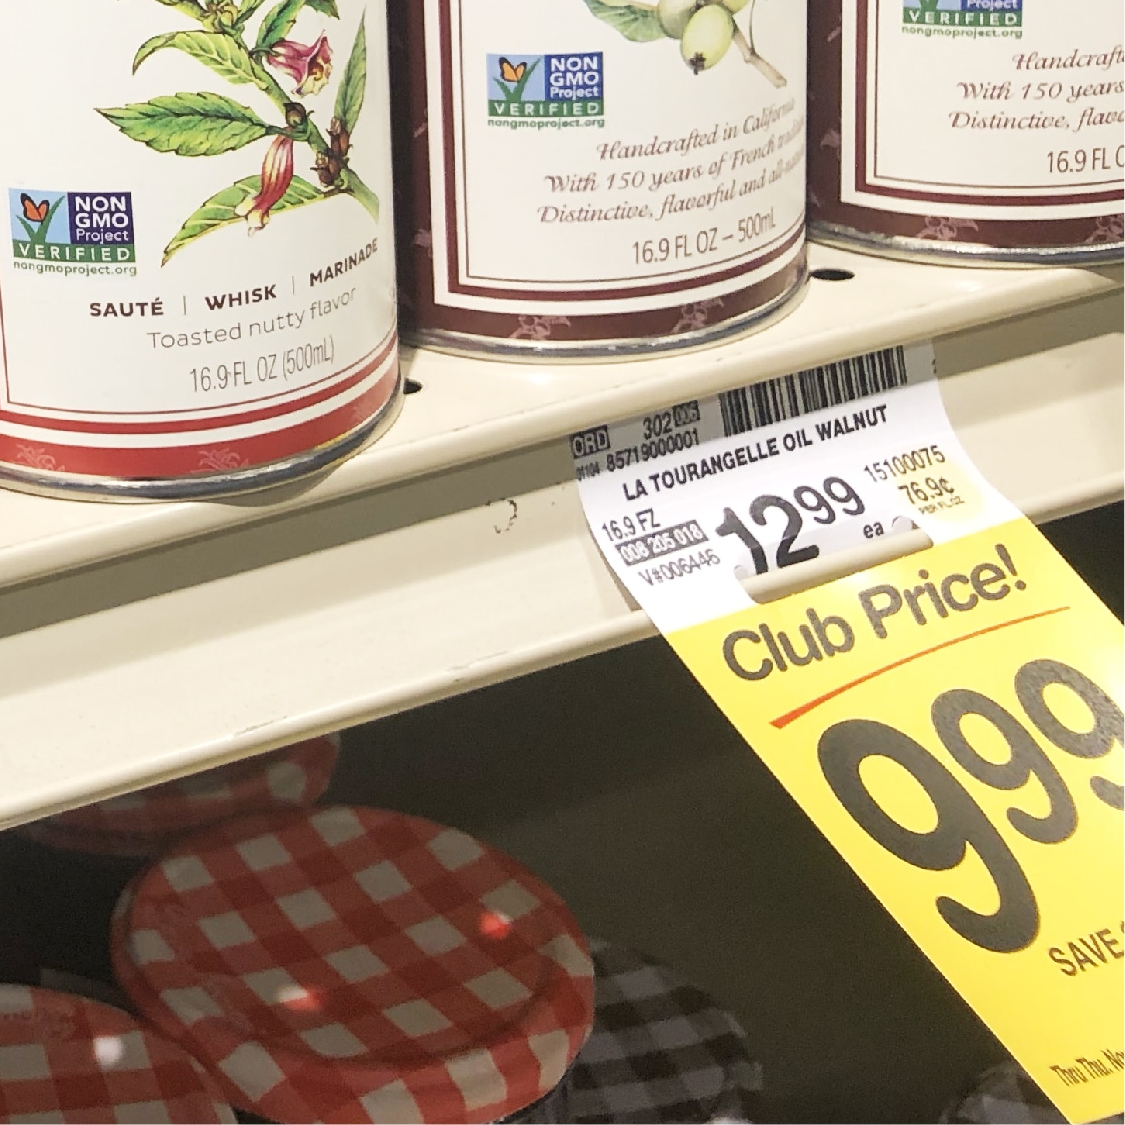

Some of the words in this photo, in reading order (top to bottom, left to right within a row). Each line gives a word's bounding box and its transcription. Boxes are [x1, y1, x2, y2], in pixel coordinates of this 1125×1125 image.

[909, 9, 1018, 25] VERIFIED
[901, 25, 1023, 39] nongmoproject.org
[550, 56, 599, 72] NON
[550, 71, 599, 87] GMO
[956, 81, 1014, 101] With
[1021, 82, 1062, 100] 150
[550, 86, 599, 100] Project
[494, 102, 600, 116] VERIFIED
[948, 110, 1070, 130] Distinctive,
[487, 117, 605, 130] nongmoproject.org
[596, 124, 720, 162] Handcrafted
[723, 121, 739, 140] in
[544, 172, 600, 194] With
[606, 170, 645, 191] 150
[650, 163, 702, 192] years
[708, 151, 728, 180] of
[730, 133, 775, 170] French
[1046, 149, 1087, 173] 16.9
[1092, 147, 1111, 170] FL
[74, 195, 127, 213] NON
[537, 201, 654, 225] Distinctive,
[655, 180, 737, 221] flavorful
[739, 167, 766, 197] and
[74, 212, 130, 229] GMO
[75, 228, 130, 245] Project
[632, 236, 670, 266] 16.9
[675, 234, 692, 259] FL
[696, 226, 718, 253] OZ
[738, 206, 776, 243] 500mL
[18, 243, 131, 261] VERIFIED
[13, 260, 138, 277] nongmoproject.org
[89, 297, 165, 318] SAUTÉ
[204, 284, 277, 312] WHISK
[309, 237, 378, 288] MARINADE
[146, 323, 242, 349] Toasted
[249, 306, 305, 336] nutty
[310, 286, 358, 321] flavor
[189, 368, 229, 393] 16.9
[232, 362, 252, 388] FL
[256, 354, 278, 380] OZ
[282, 335, 335, 380] (500mL)
[573, 428, 609, 457] ORD
[643, 412, 672, 440] 302
[607, 427, 699, 472] 85719000001
[623, 478, 649, 501] LA
[649, 437, 779, 493] TOURANGELLE
[782, 430, 813, 452] OIL
[816, 404, 888, 441] WALNUT
[864, 445, 945, 482] 15100075
[602, 516, 636, 541] 16.9
[635, 507, 660, 531] FZ
[863, 521, 885, 540] ea
[621, 541, 649, 562] 008
[648, 532, 675, 553] 205
[723, 609, 855, 682] Club
[858, 543, 1027, 640] Price!
[1048, 928, 1125, 977] SAVE
